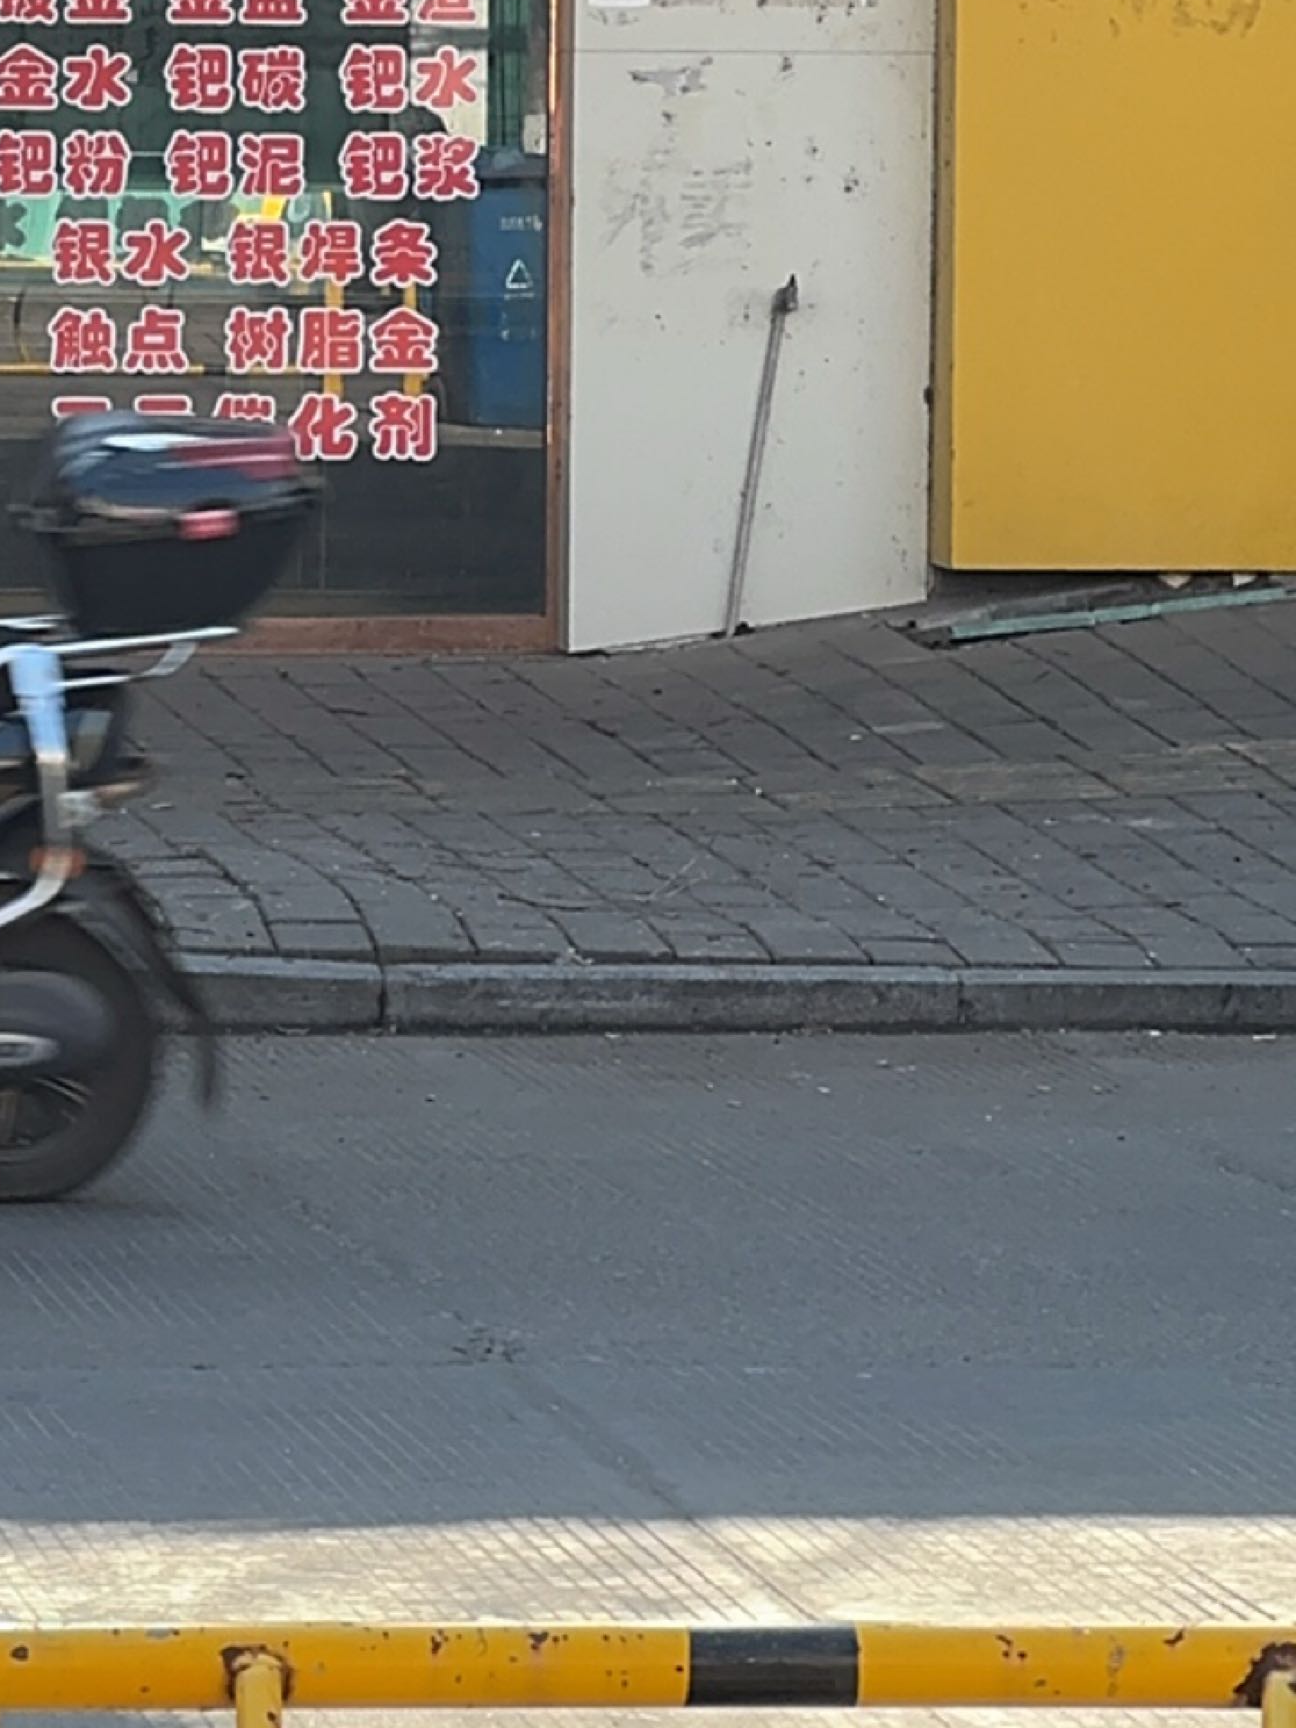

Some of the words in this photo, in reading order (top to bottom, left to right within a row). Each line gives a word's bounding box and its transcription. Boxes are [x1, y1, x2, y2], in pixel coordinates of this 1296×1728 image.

[166, 42, 306, 112] 钯碳
[341, 42, 480, 112] 钯水
[166, 129, 306, 200] 钯泥
[341, 129, 480, 200] 钯浆
[51, 218, 190, 286] 银水
[227, 218, 437, 287] 银焊条
[49, 305, 190, 373] 触点
[225, 305, 438, 373] 树脂金
